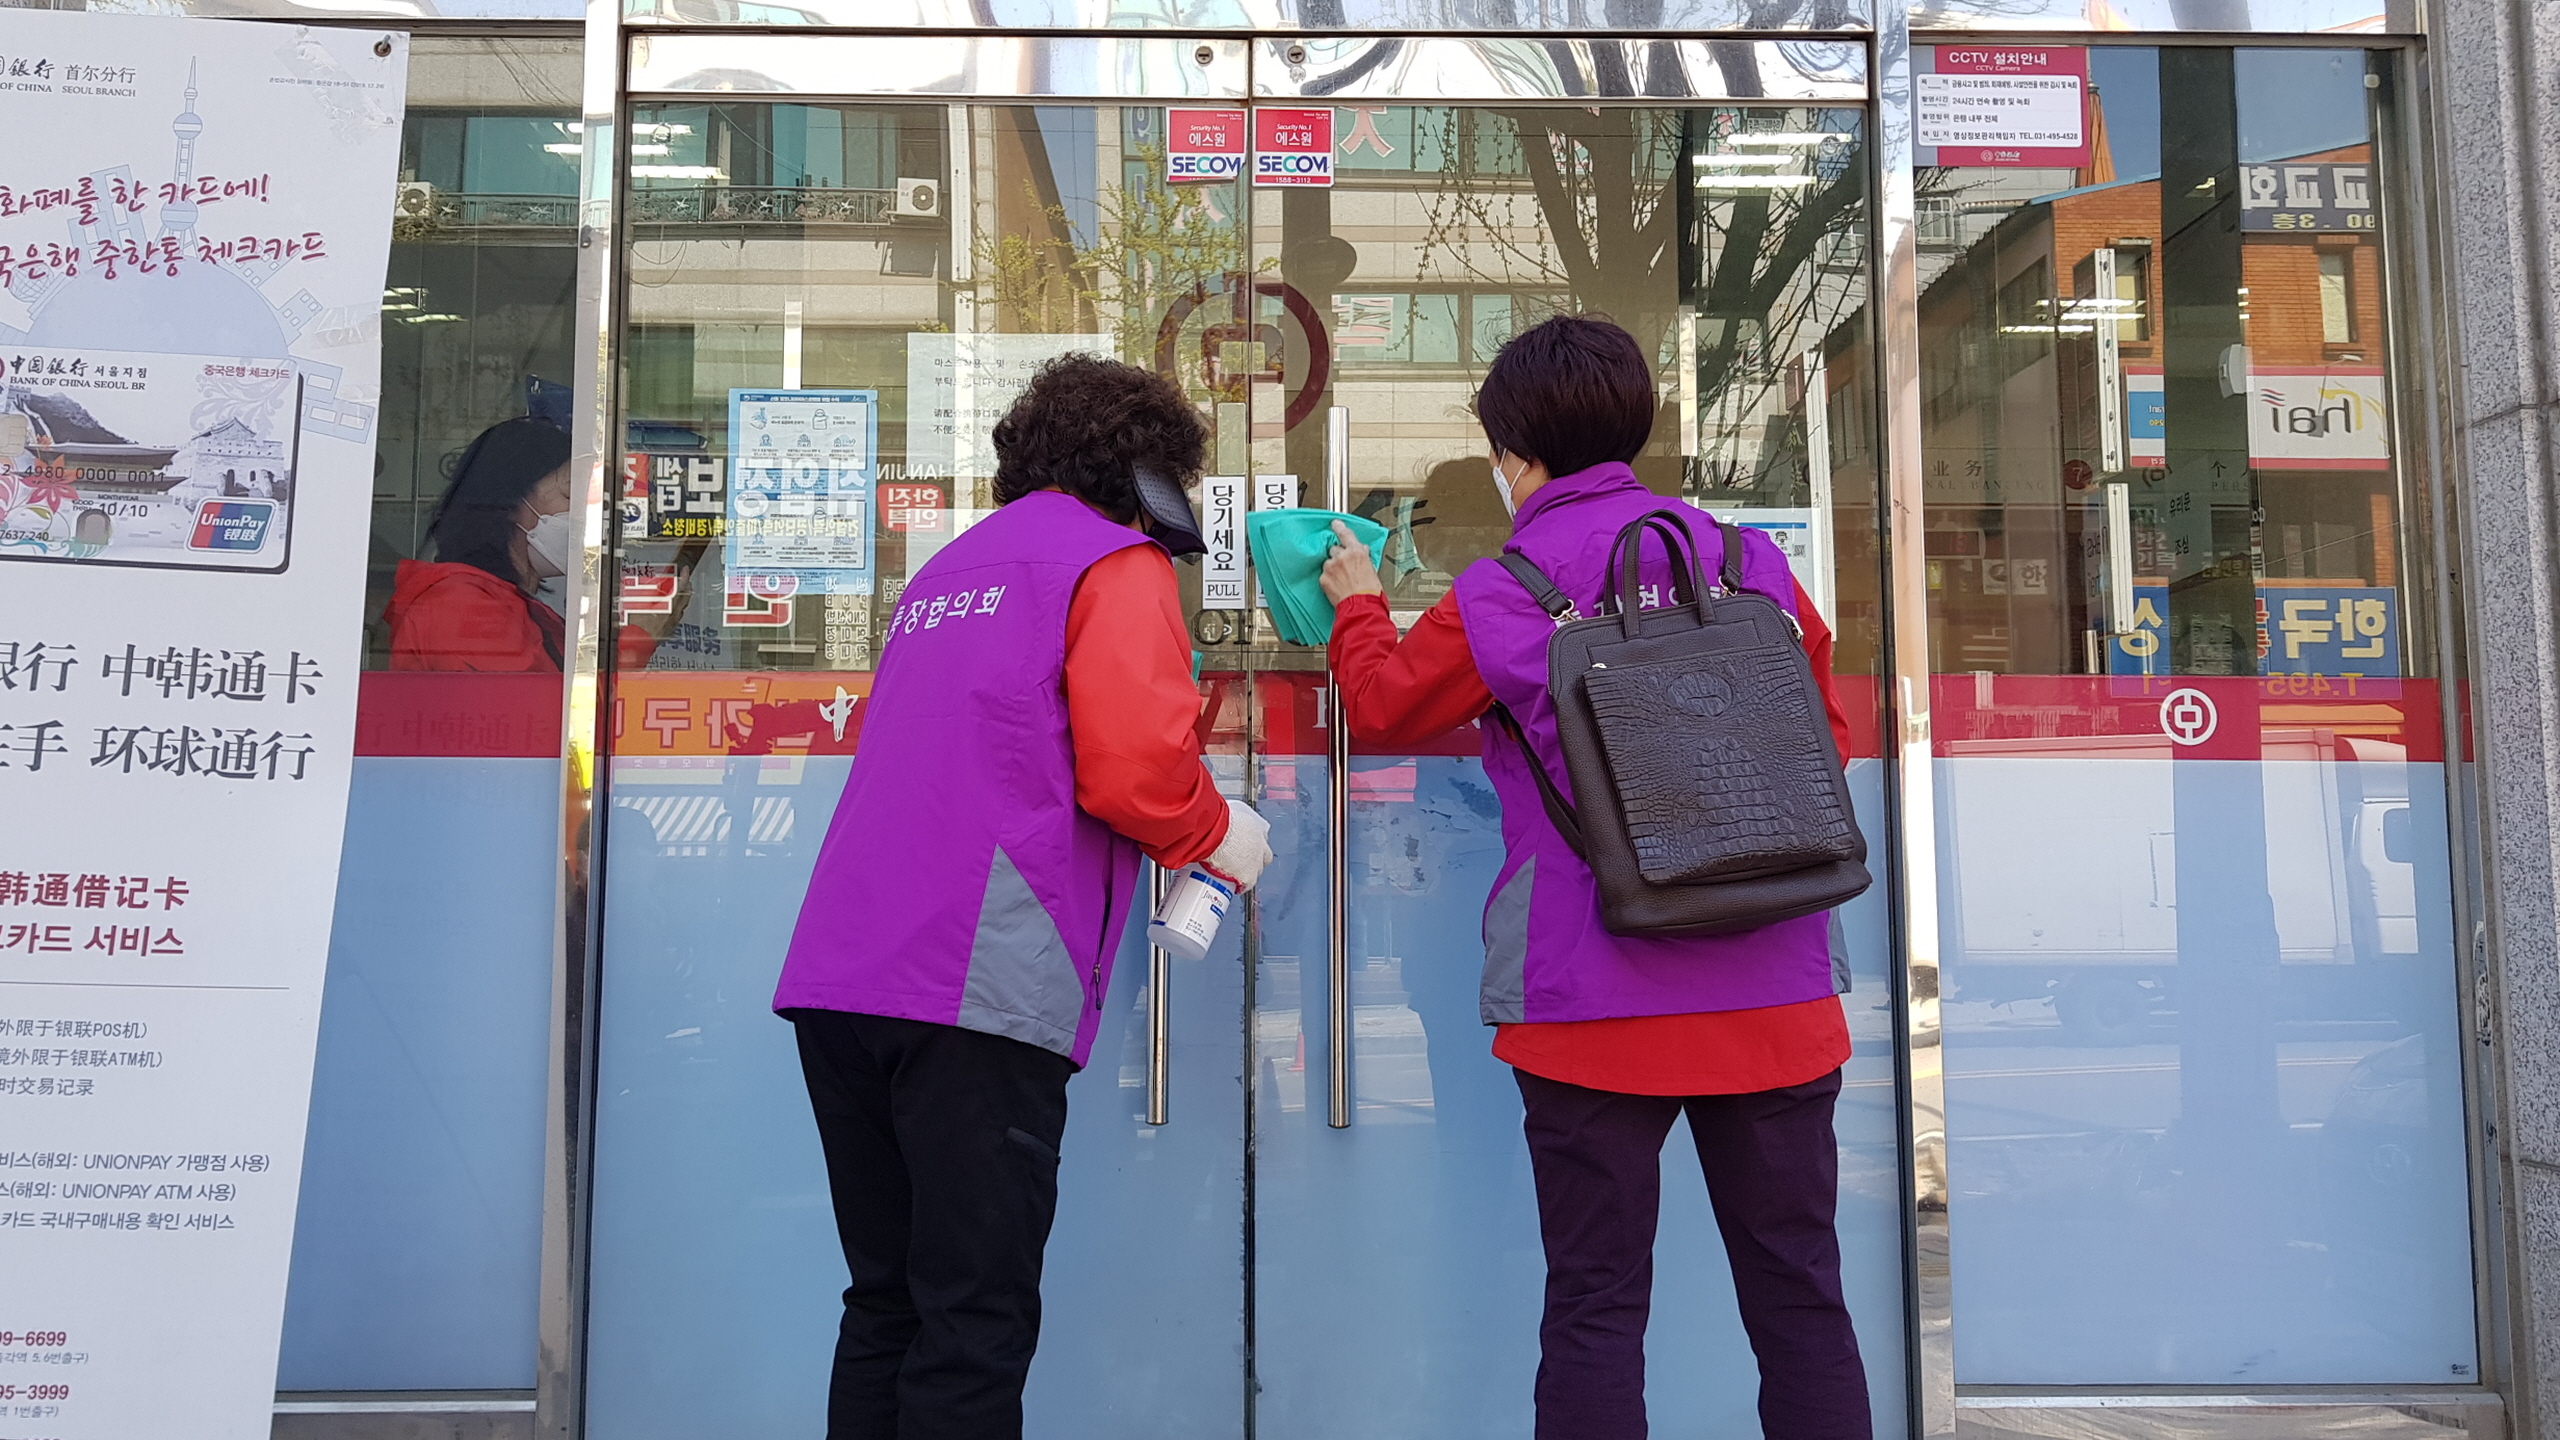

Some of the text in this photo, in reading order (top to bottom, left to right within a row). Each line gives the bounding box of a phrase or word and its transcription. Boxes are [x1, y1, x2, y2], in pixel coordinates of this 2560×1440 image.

[1949, 52, 2048, 66] CCTV 설치안내
[65, 64, 136, 84] 首尔分行
[0, 82, 136, 97] OF CHINA SEOUL BRANCH
[1952, 97, 1975, 105] 24시간
[1190, 124, 1210, 132] Security
[1189, 132, 1226, 147] 에스원
[1275, 131, 1313, 147] 에스원
[1172, 156, 1241, 174] SECOM
[1259, 155, 1329, 173] SECOM
[109, 178, 147, 212] 한
[158, 174, 271, 205] 카드에!
[93, 237, 185, 281] 중한통
[199, 231, 328, 266] 체크카드
[94, 366, 148, 379] 서울지점
[204, 364, 291, 379] 중국은행 체크카드
[9, 376, 146, 391] BANK OF CHINA SEOUL BR
[934, 377, 992, 388] 부탁드니다
[24, 465, 65, 479] 4980
[75, 467, 117, 482] 0000
[127, 471, 166, 484] 0011
[1933, 459, 1982, 477] 业务
[1971, 480, 2045, 490] BANING
[99, 502, 148, 518] 10/10
[201, 513, 265, 533] UnionPay
[1211, 485, 1237, 572] 당기세요
[224, 528, 257, 541] 银联
[1207, 584, 1241, 597] PULL
[102, 644, 324, 704] 中韩通卡
[90, 725, 316, 781] 环球通行
[0, 871, 190, 911] 韩通借记卡
[84, 925, 184, 957] 서비스
[0, 1077, 95, 1097] 时交易记录
[83, 1154, 173, 1170] UNIONPAY
[176, 1154, 227, 1172] 가맹점
[230, 1155, 270, 1172] 사용)
[62, 1183, 151, 1199] UNIONPAY
[154, 1184, 193, 1200] ATM
[196, 1184, 237, 1202] 사용)
[1, 1211, 235, 1230] 카드 국내구매내용 확인 서비스
